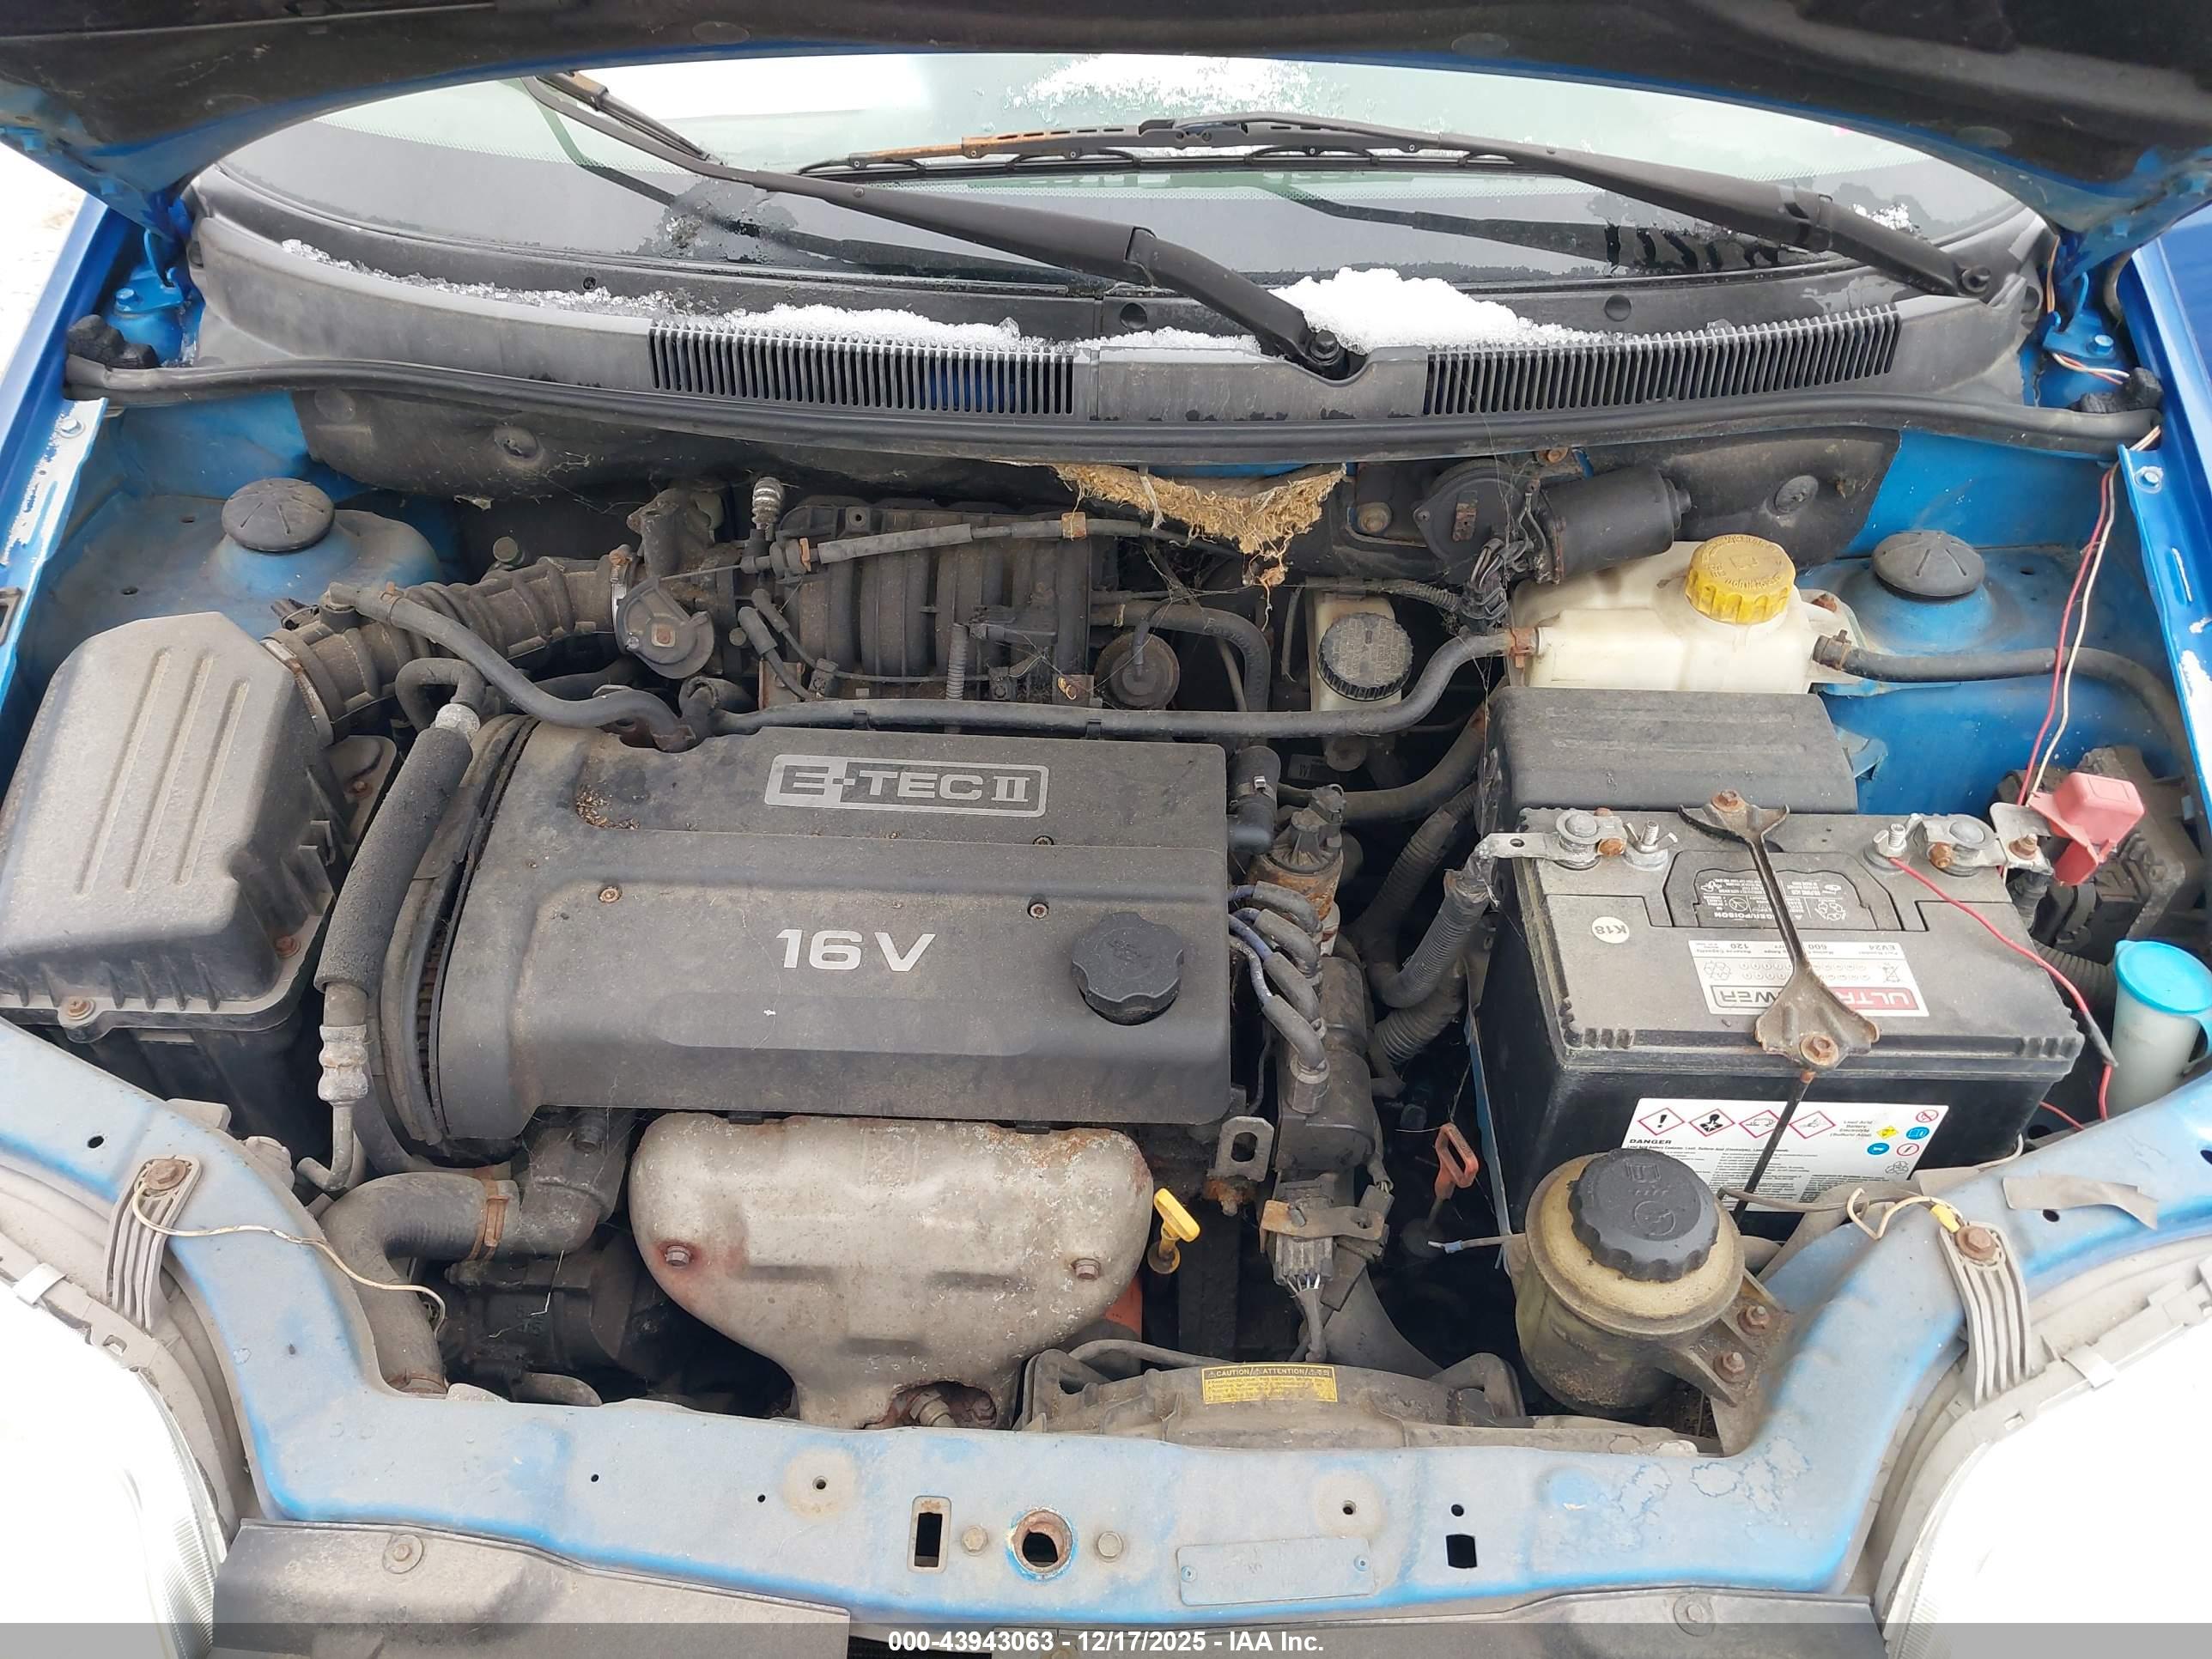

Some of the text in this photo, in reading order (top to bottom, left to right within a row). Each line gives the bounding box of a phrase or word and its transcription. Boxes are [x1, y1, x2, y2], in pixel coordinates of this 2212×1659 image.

[779, 764, 1031, 803] E-TEC II
[1595, 925, 1627, 935] K18
[1720, 991, 1911, 1005] ULTR WER
